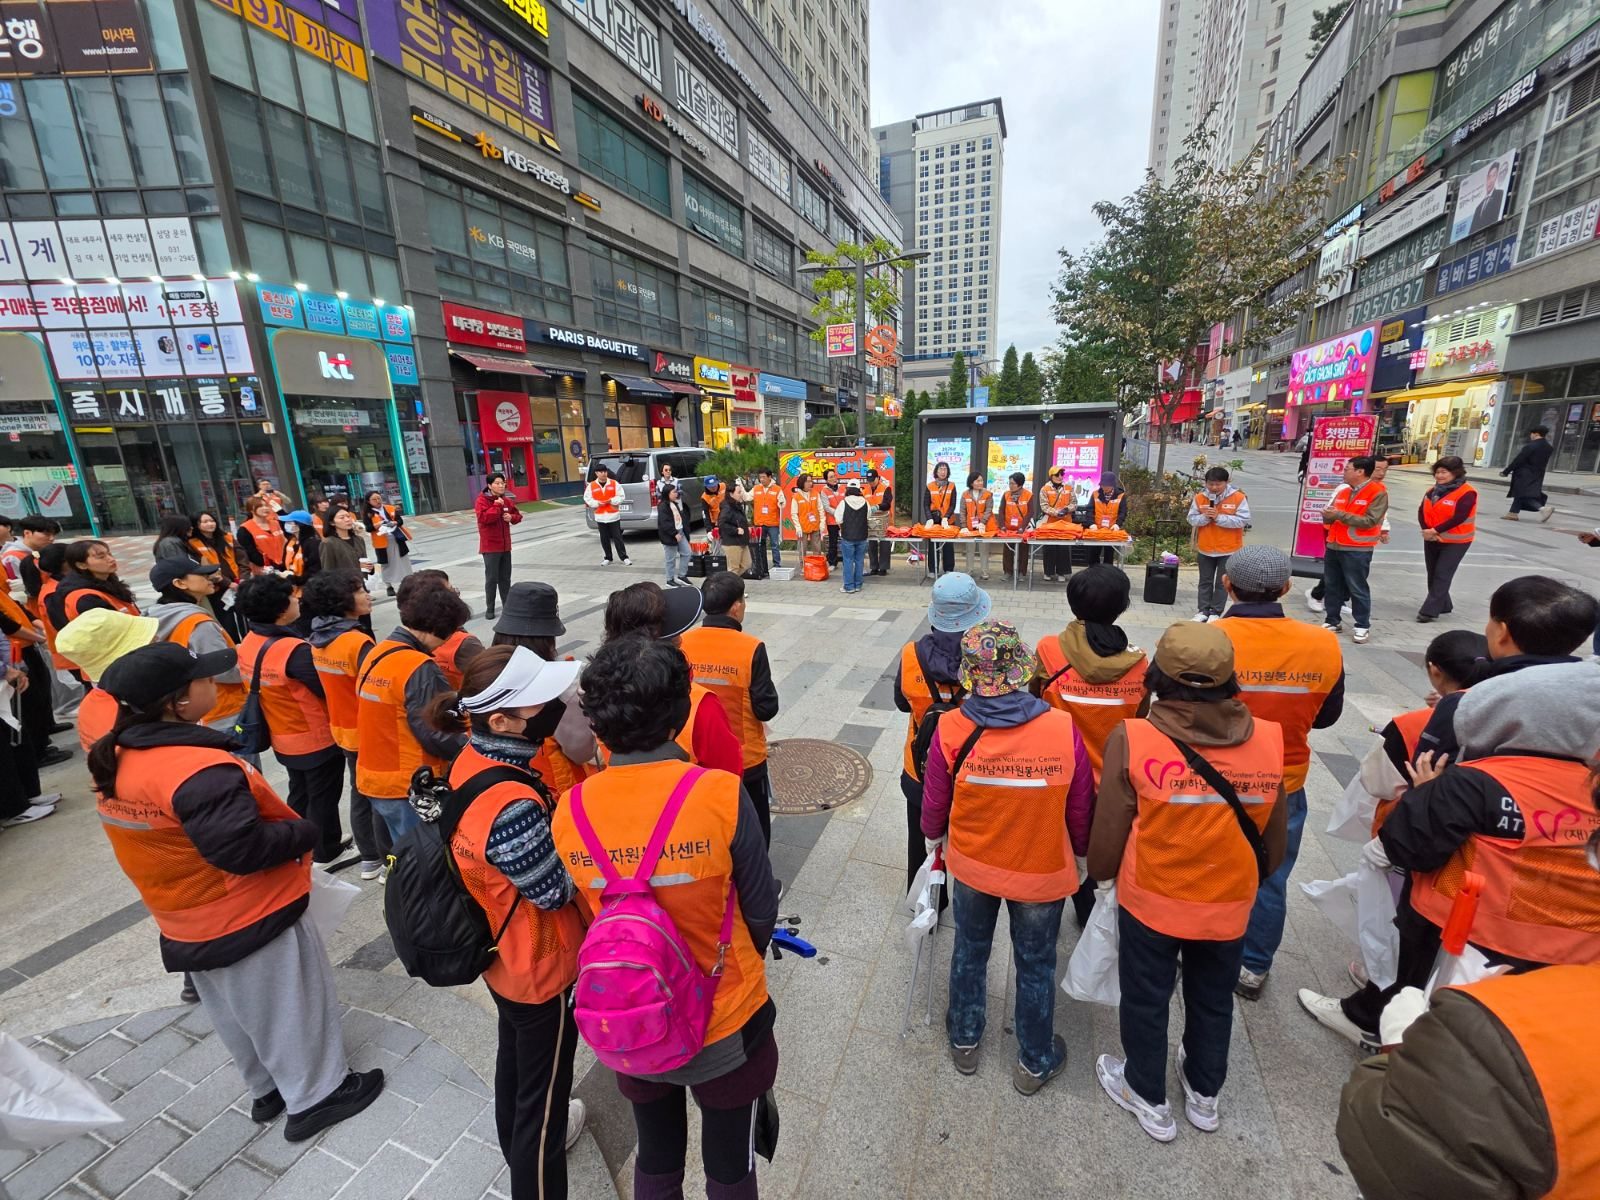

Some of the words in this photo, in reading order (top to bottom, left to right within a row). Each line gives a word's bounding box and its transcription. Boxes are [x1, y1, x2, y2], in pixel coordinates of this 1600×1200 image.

[0, 18, 43, 60] 행
[102, 27, 136, 43] 미사역
[1496, 69, 1538, 117] 김용만
[643, 94, 664, 122] KD
[676, 59, 738, 148] 미술학원
[503, 147, 570, 194] KB국민은행
[684, 194, 698, 213] KD
[488, 233, 504, 249] KB
[507, 239, 536, 260] 국민은행
[627, 283, 638, 295] KB
[52, 296, 149, 315] 직영점에서!
[189, 301, 220, 318] 증정
[307, 299, 338, 315] 인터넷
[829, 326, 854, 336] STAGE
[550, 327, 585, 346] PARIS
[587, 336, 639, 356] BAGUETTE
[76, 353, 117, 367] 100%
[1326, 427, 1360, 439] 첫방문
[1315, 439, 1335, 451] 리뷰
[1336, 439, 1370, 451] 이벤트!
[1256, 770, 1281, 779] Center
[568, 838, 711, 867] 하남자원사센터
